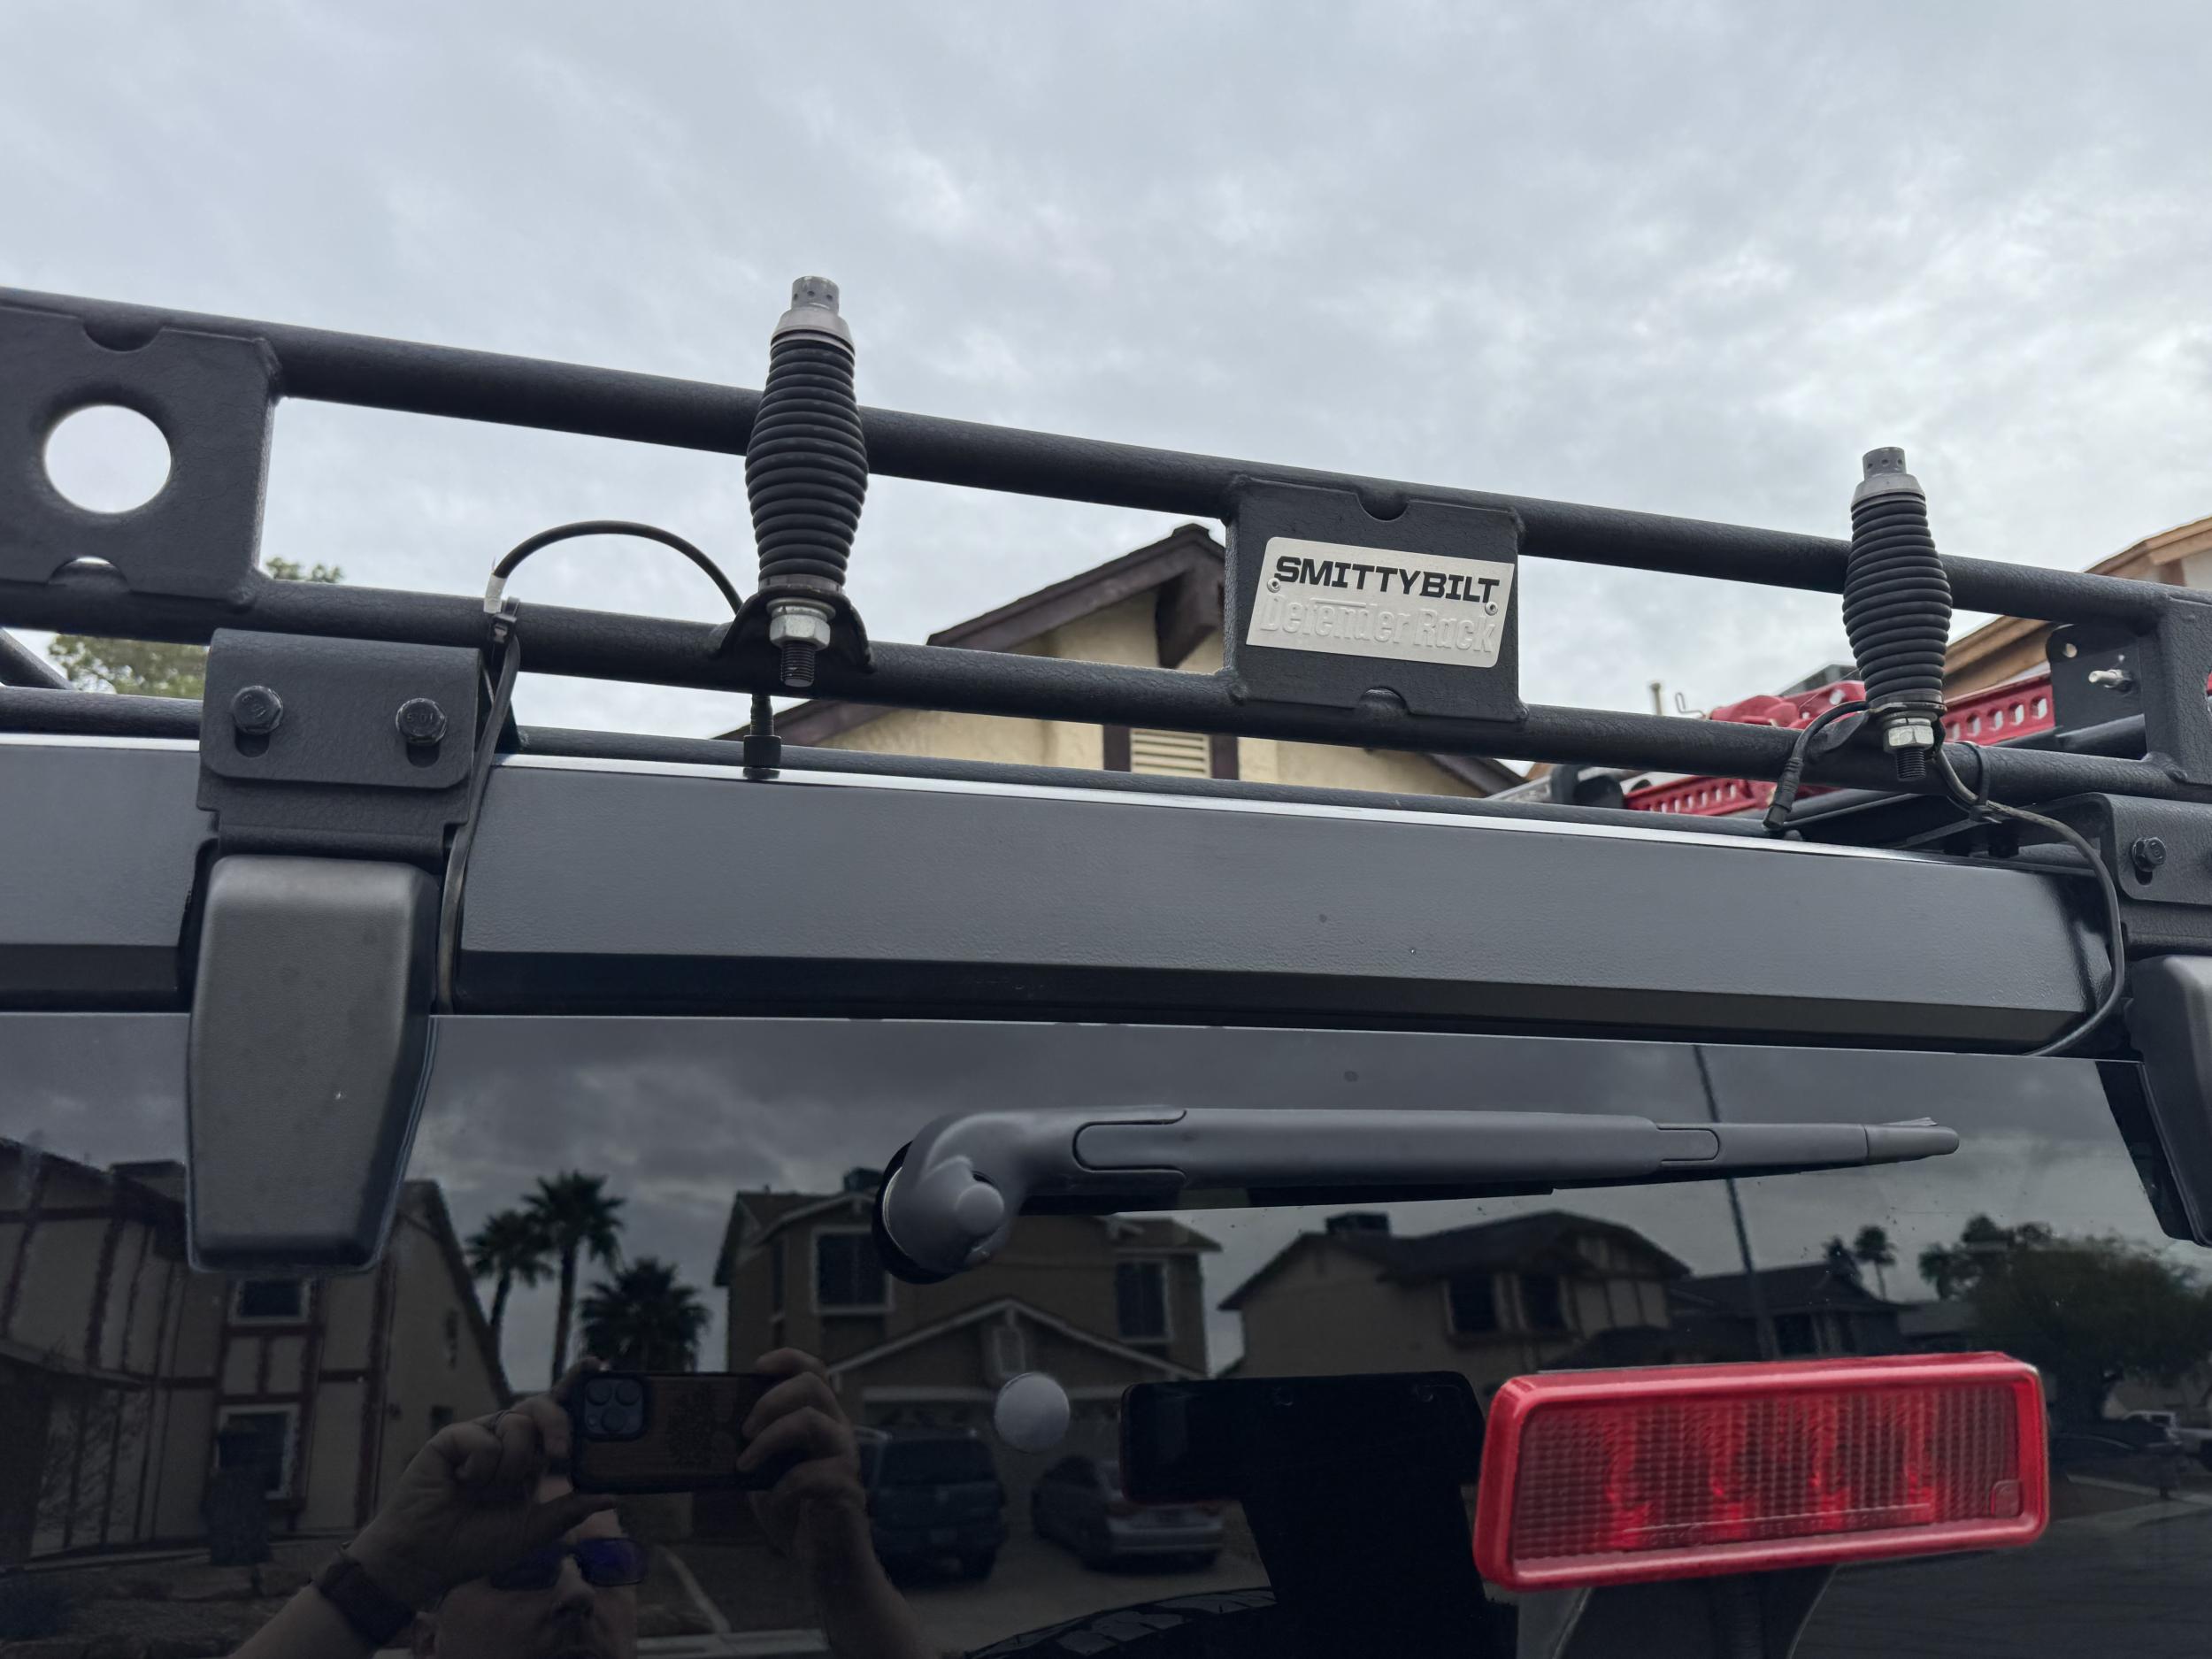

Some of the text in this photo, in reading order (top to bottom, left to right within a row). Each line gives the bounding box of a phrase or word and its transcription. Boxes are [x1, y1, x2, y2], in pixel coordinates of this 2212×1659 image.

[1274, 556, 1500, 603] SMITTYBILT
[1260, 594, 1496, 653] Defender Rack
